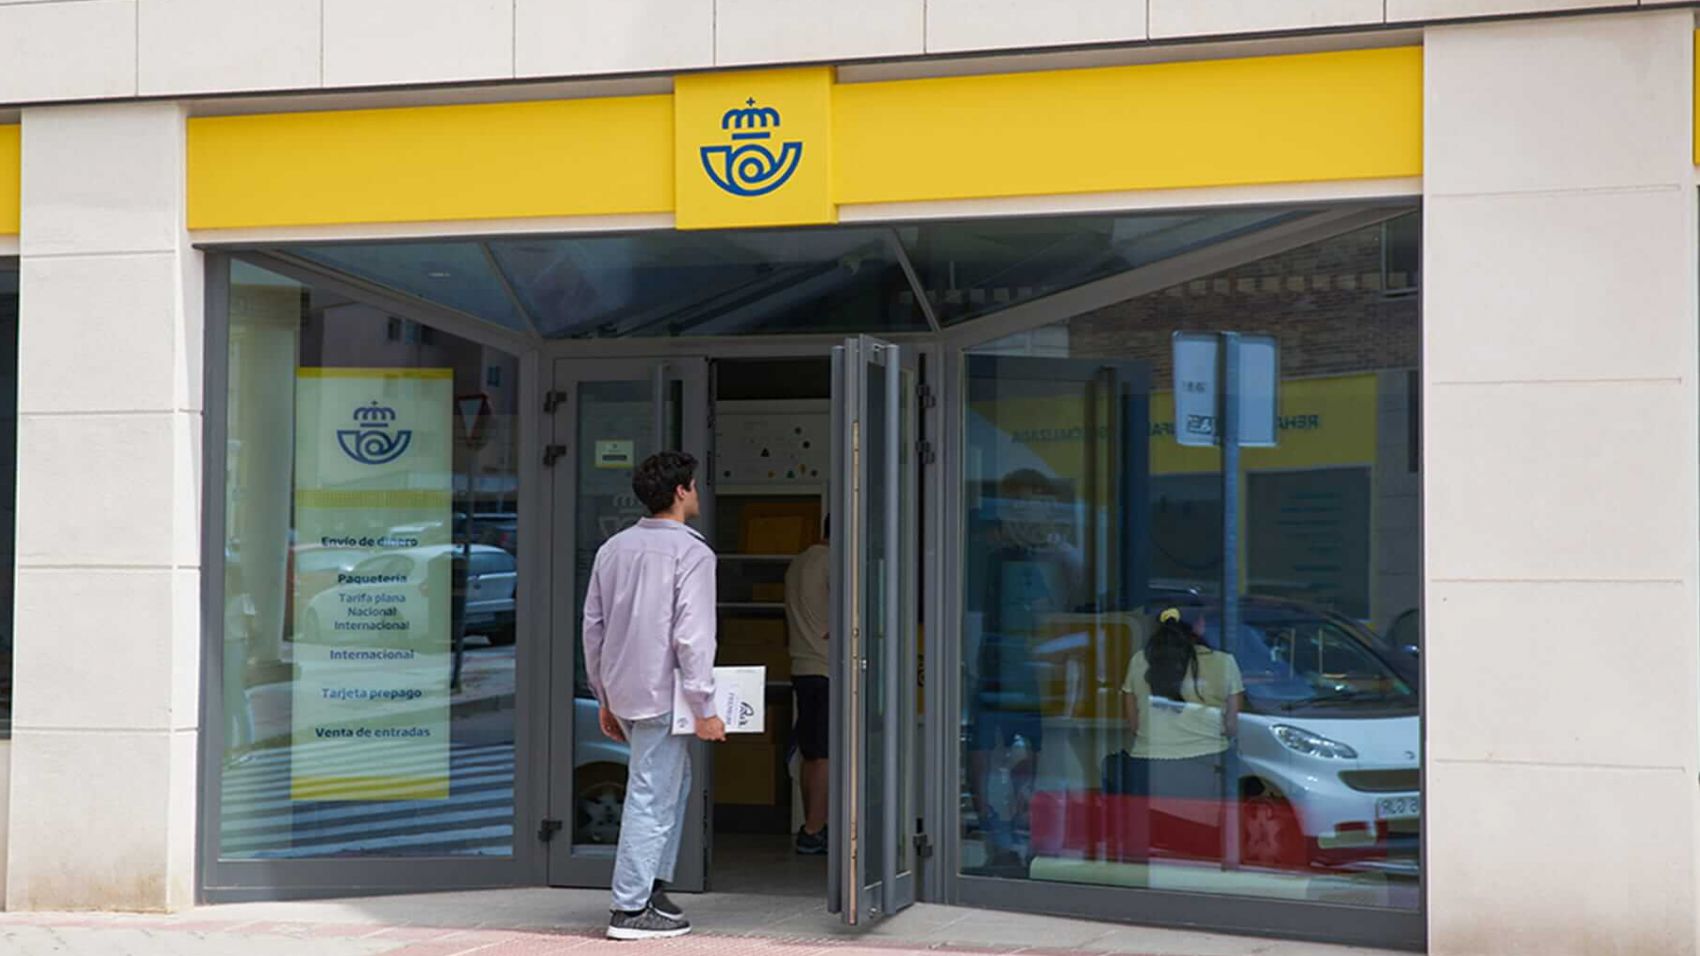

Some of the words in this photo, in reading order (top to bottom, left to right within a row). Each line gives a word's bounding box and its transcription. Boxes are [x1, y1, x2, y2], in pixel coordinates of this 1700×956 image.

[321, 536, 357, 547] Envío
[358, 537, 375, 547] de
[377, 537, 418, 547] dinero
[338, 574, 408, 584] Paquetería
[339, 593, 372, 602] Tarifa
[372, 594, 406, 604] plana
[348, 607, 398, 616] Nacional
[334, 621, 410, 631] Internacional
[330, 649, 414, 660] Internacional
[322, 688, 368, 700] Tarjeta
[369, 689, 422, 700] prepago
[315, 728, 353, 738] Venta
[356, 727, 371, 738] de
[374, 727, 430, 738] entradas
